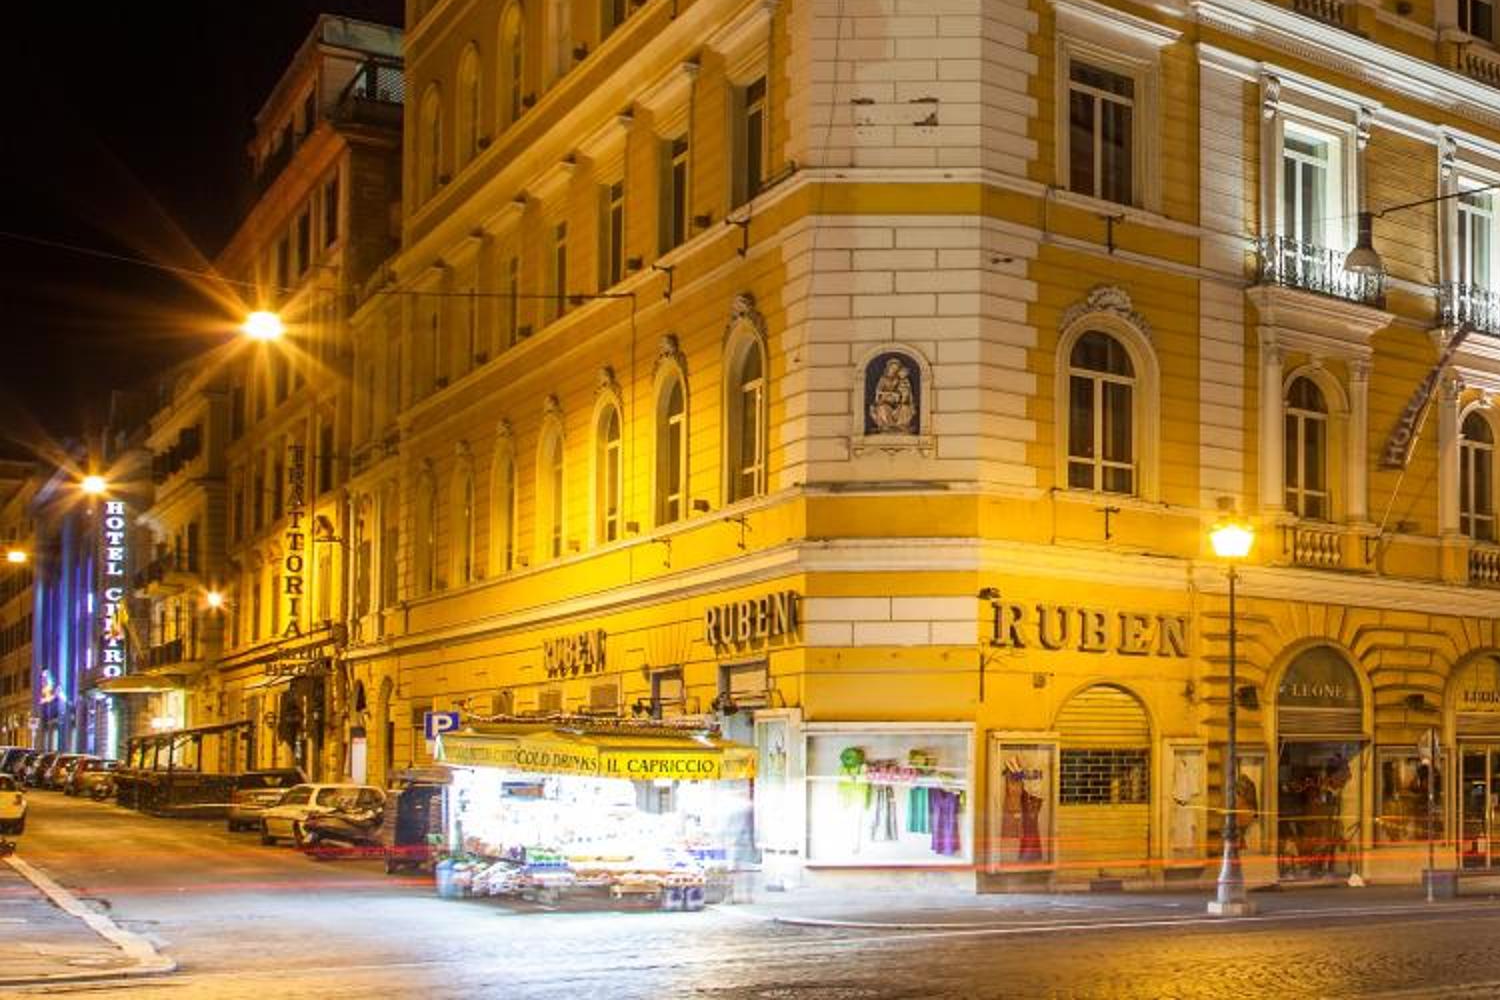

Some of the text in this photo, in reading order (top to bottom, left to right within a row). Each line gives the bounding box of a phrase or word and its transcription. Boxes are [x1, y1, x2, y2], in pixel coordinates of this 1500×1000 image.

[104, 502, 125, 575] HOTEL
[284, 445, 304, 639] TRATTORIA
[704, 590, 801, 647] RUBEN
[989, 600, 1190, 658] RUBEN
[431, 714, 453, 739] P
[516, 747, 549, 767] COLD
[552, 751, 598, 774] DRINKS
[606, 758, 621, 773] IL
[626, 758, 715, 774] CAPRICCIO
